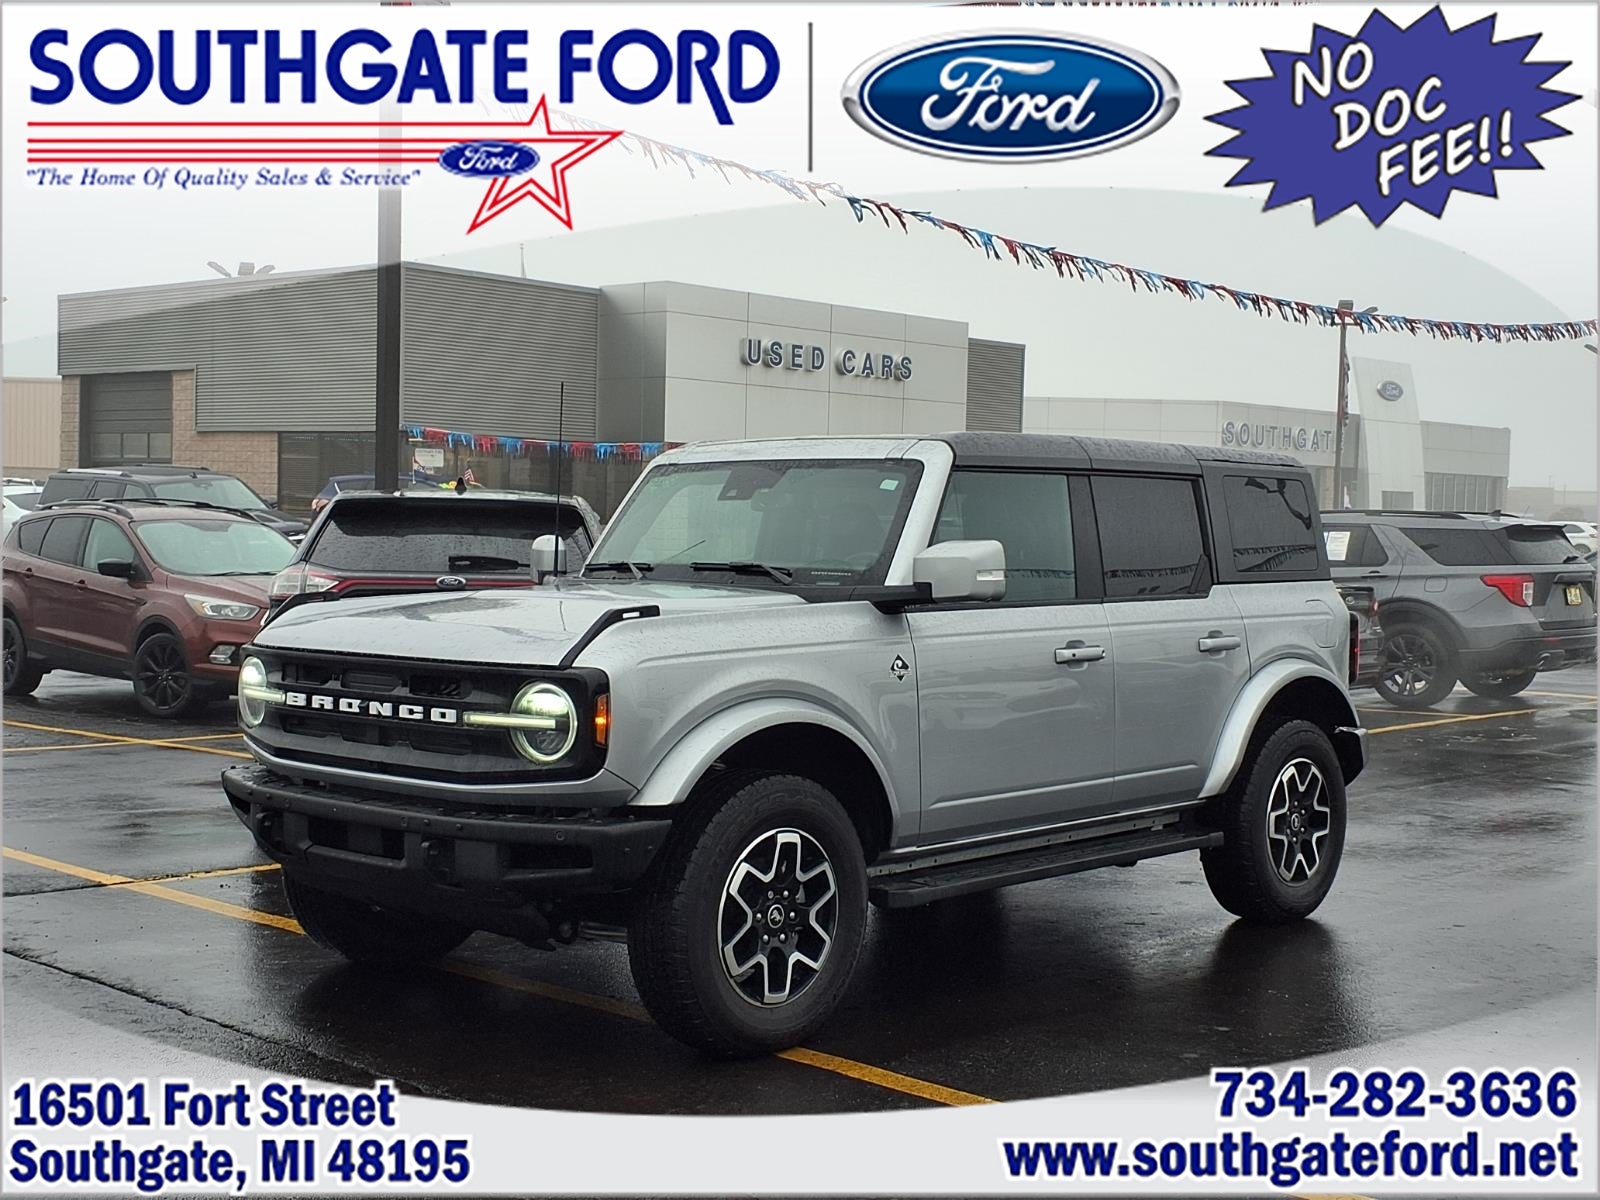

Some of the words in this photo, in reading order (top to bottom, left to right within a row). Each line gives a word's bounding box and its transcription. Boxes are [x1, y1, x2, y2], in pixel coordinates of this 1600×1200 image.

[746, 338, 825, 371] USED
[841, 349, 912, 380] CARS
[1224, 420, 1334, 450] SOUTHGAT
[286, 691, 457, 723] BRONCO
